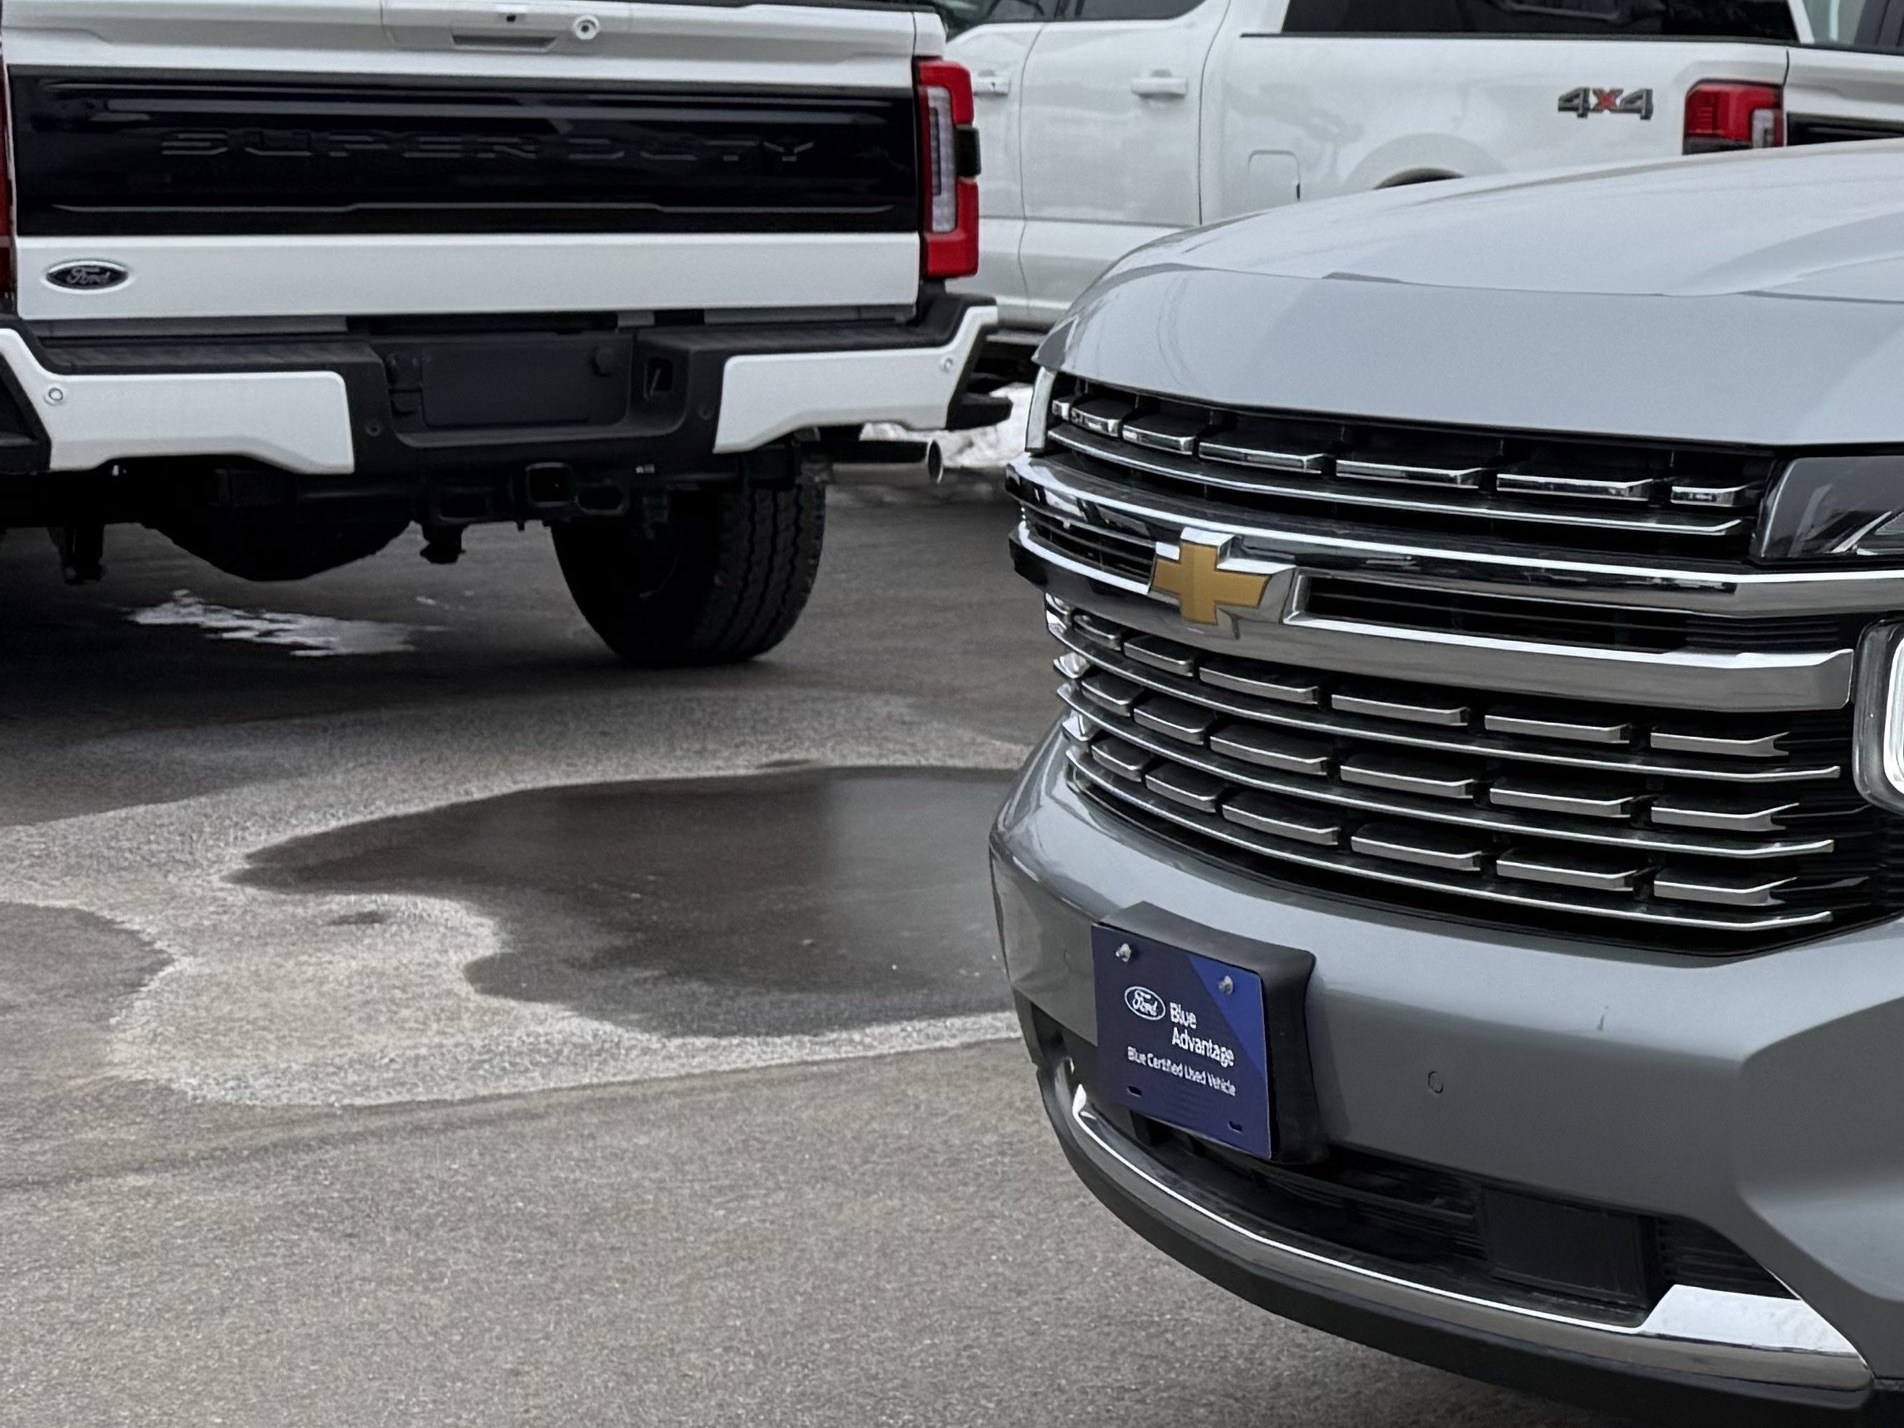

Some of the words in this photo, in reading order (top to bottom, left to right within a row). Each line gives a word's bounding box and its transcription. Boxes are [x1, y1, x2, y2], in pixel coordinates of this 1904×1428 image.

[161, 129, 538, 159] SUPER
[565, 136, 815, 163] DUTY
[1169, 1002, 1197, 1029] Blue
[1171, 1026, 1235, 1068] Advantage
[1127, 1046, 1147, 1066] Blue
[1147, 1053, 1183, 1079] Certified
[1184, 1065, 1207, 1086] Used
[1207, 1071, 1237, 1097] Vehicle
